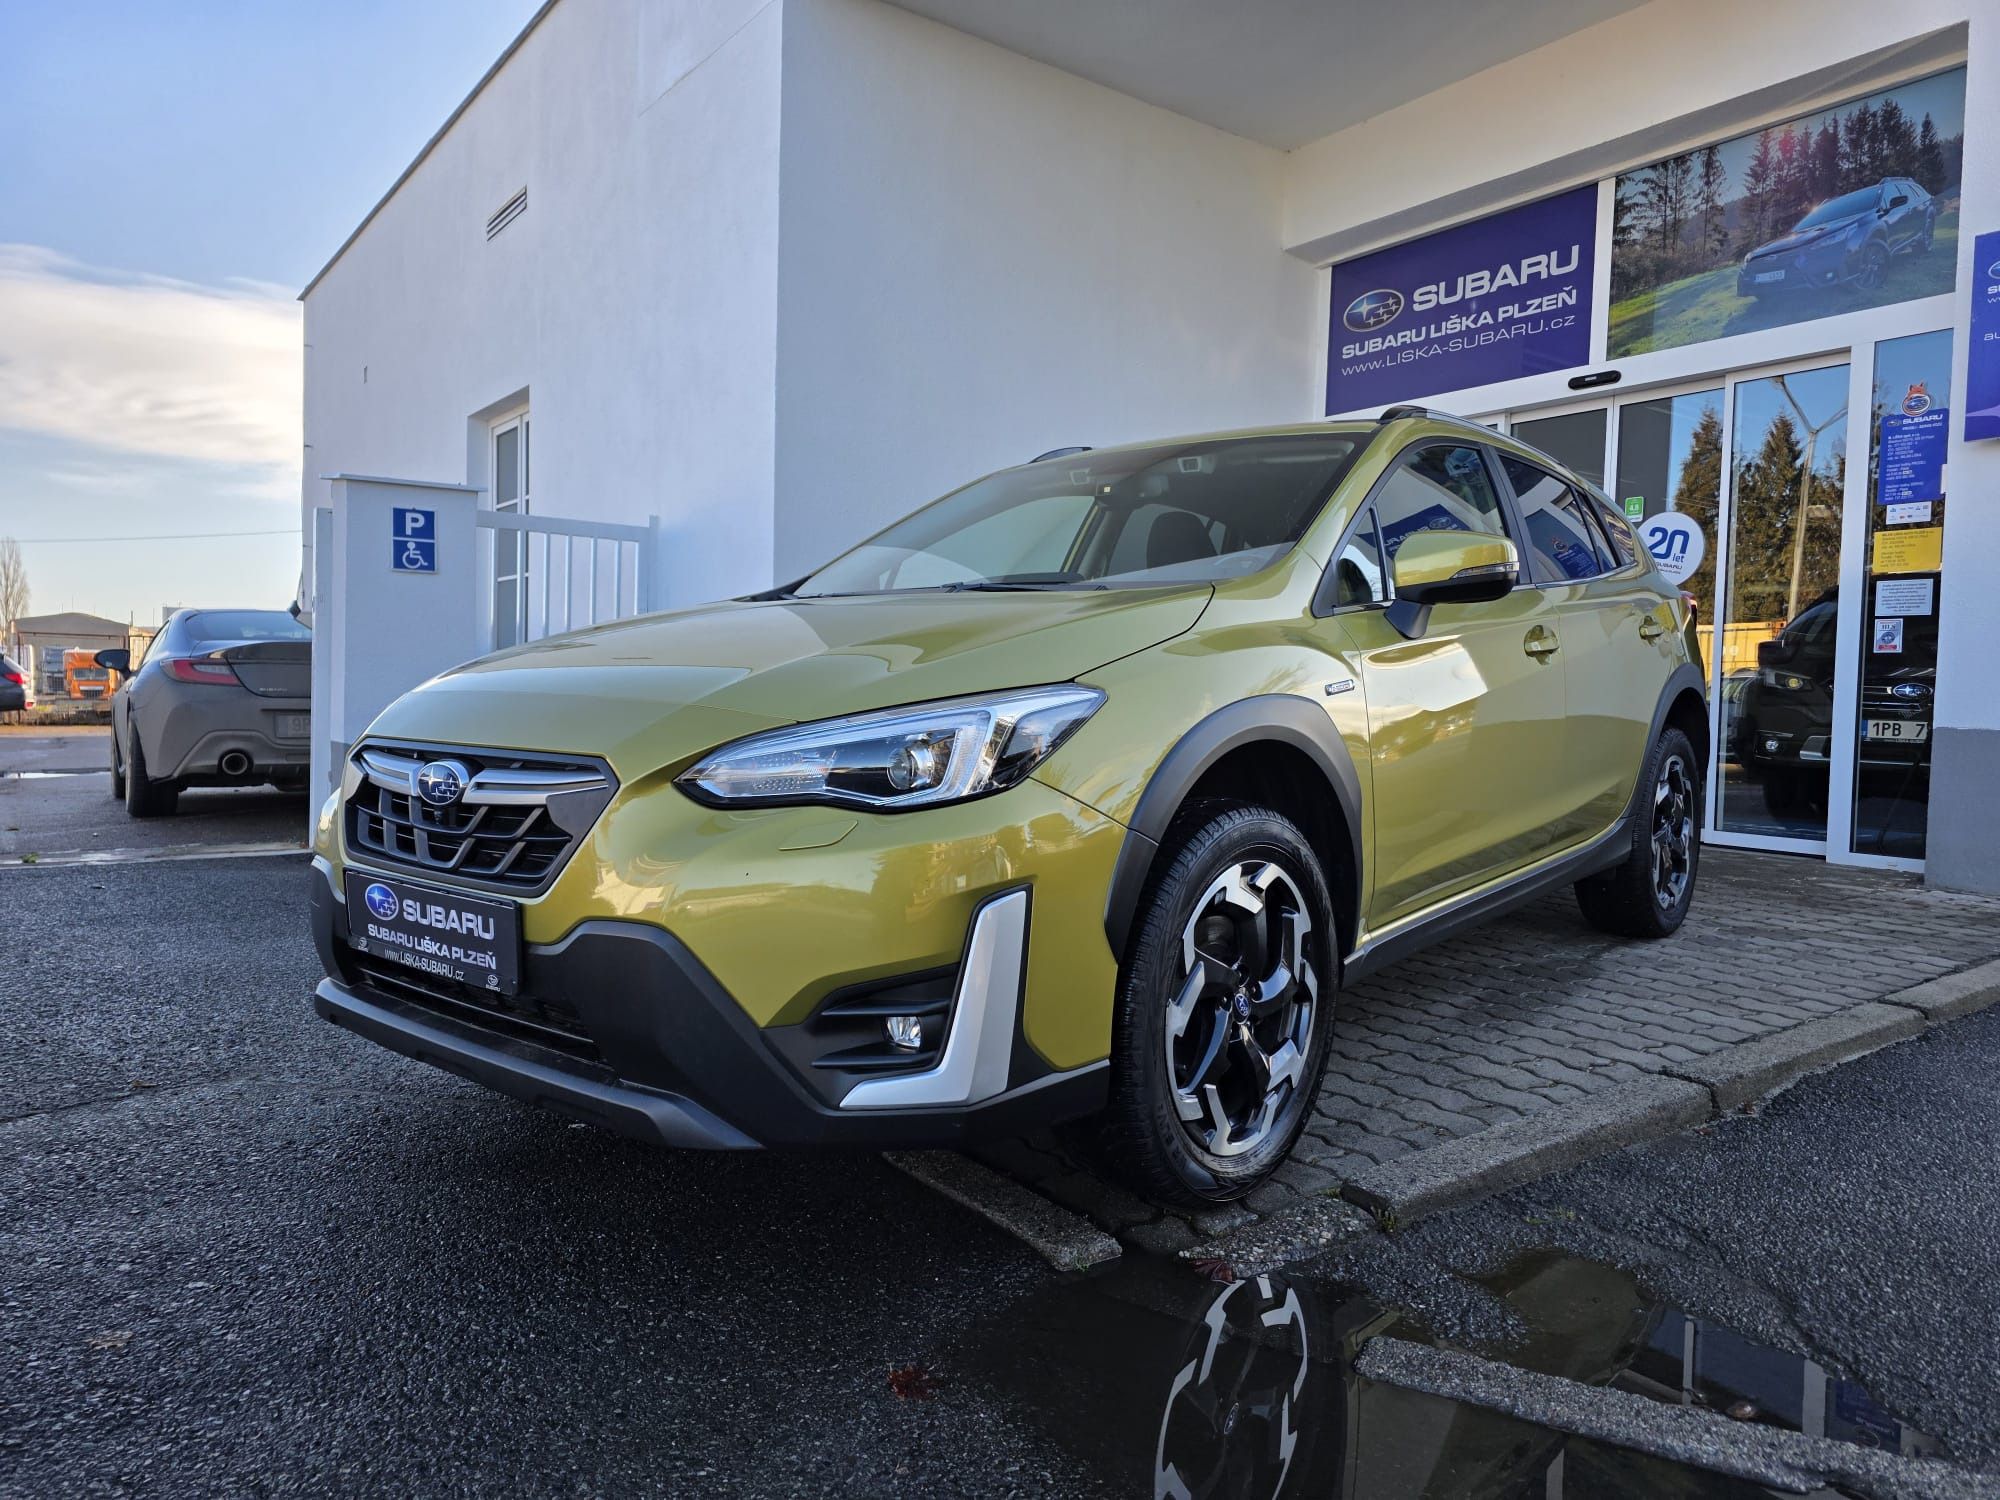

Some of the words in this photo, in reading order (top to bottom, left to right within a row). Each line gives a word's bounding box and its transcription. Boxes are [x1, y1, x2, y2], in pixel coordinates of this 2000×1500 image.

[1412, 244, 1579, 312] SUBARU
[1341, 326, 1426, 360] SUBARU
[1429, 313, 1495, 340] LIŠKA
[1497, 285, 1577, 321] PLZEŇ
[1902, 413, 1944, 425] SUBARU
[405, 511, 425, 536] P
[1672, 553, 1685, 563] let
[1872, 722, 1902, 737] 1PB
[402, 899, 495, 940] SUBARU
[367, 923, 414, 951] SUBARU
[414, 936, 451, 959] LIŠKA
[451, 949, 497, 970] PLZEŇ
